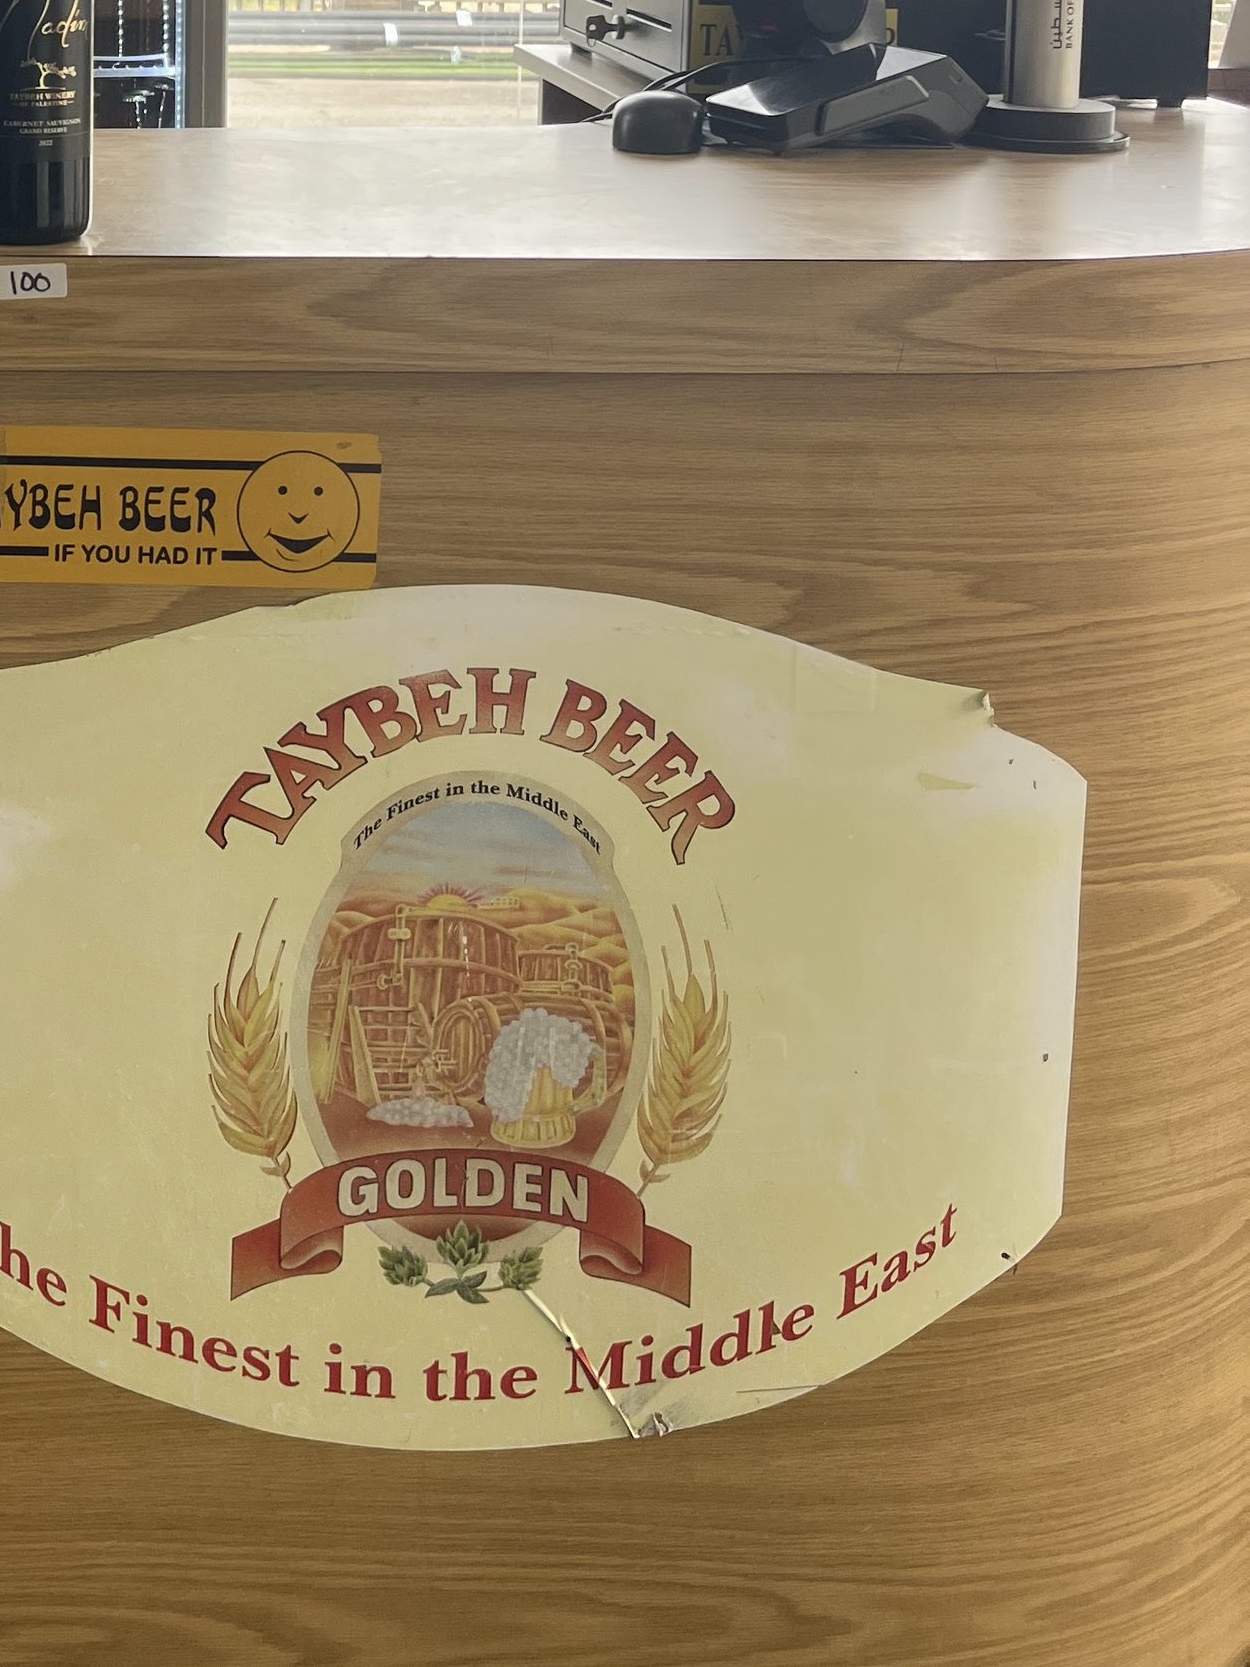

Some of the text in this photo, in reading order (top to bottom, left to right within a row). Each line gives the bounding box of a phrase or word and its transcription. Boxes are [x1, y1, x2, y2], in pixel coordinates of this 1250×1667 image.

[1066, 1, 1076, 16] OF
[1065, 19, 1075, 49] BANK
[9, 90, 77, 101] TAYBEH WINERY
[3, 117, 82, 128] CABERNET SAUVIGNON
[19, 127, 69, 135] GRAND RESERVE
[9, 270, 51, 294] 100
[119, 485, 217, 536] BEER
[55, 545, 217, 565] IF YOU HAD IT
[205, 667, 736, 865] TAYBEH BEER
[353, 780, 601, 855] The Finest in the Middle East
[336, 1154, 591, 1222] GOLDEN
[88, 1274, 302, 1390] Finest
[323, 1343, 396, 1400] in
[423, 1350, 539, 1401] the
[564, 1302, 814, 1396] Middle
[835, 1200, 958, 1319] East
